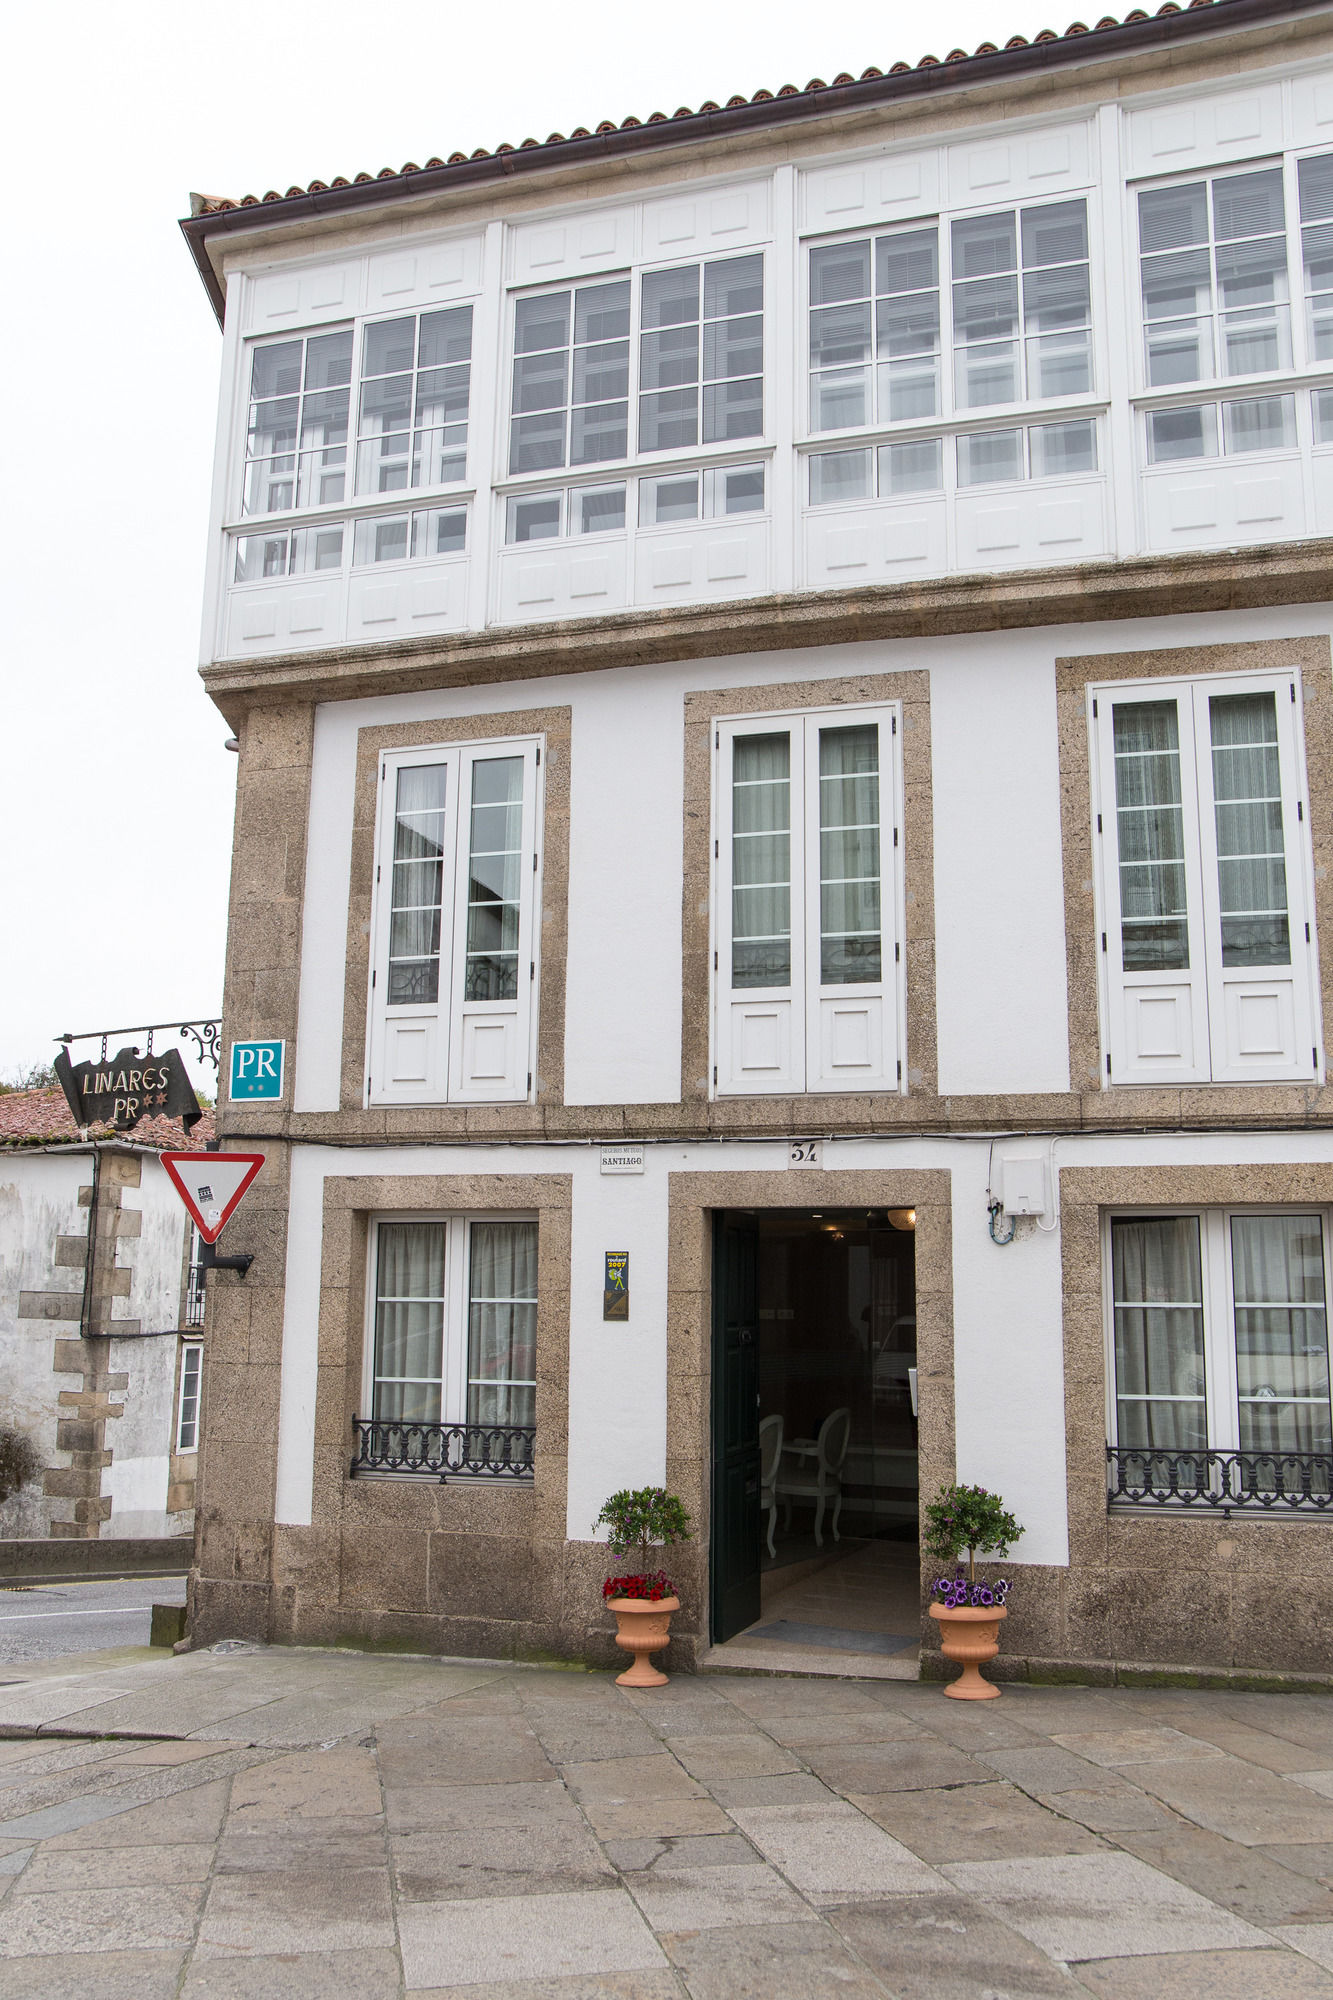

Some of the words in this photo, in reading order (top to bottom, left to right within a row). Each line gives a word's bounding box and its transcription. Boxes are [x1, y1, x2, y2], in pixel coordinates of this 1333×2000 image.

[236, 1048, 278, 1079] PR
[82, 1066, 170, 1096] LINARES
[113, 1096, 140, 1119] PR
[602, 1157, 642, 1166] SANTIAGO
[791, 1142, 818, 1162] 34
